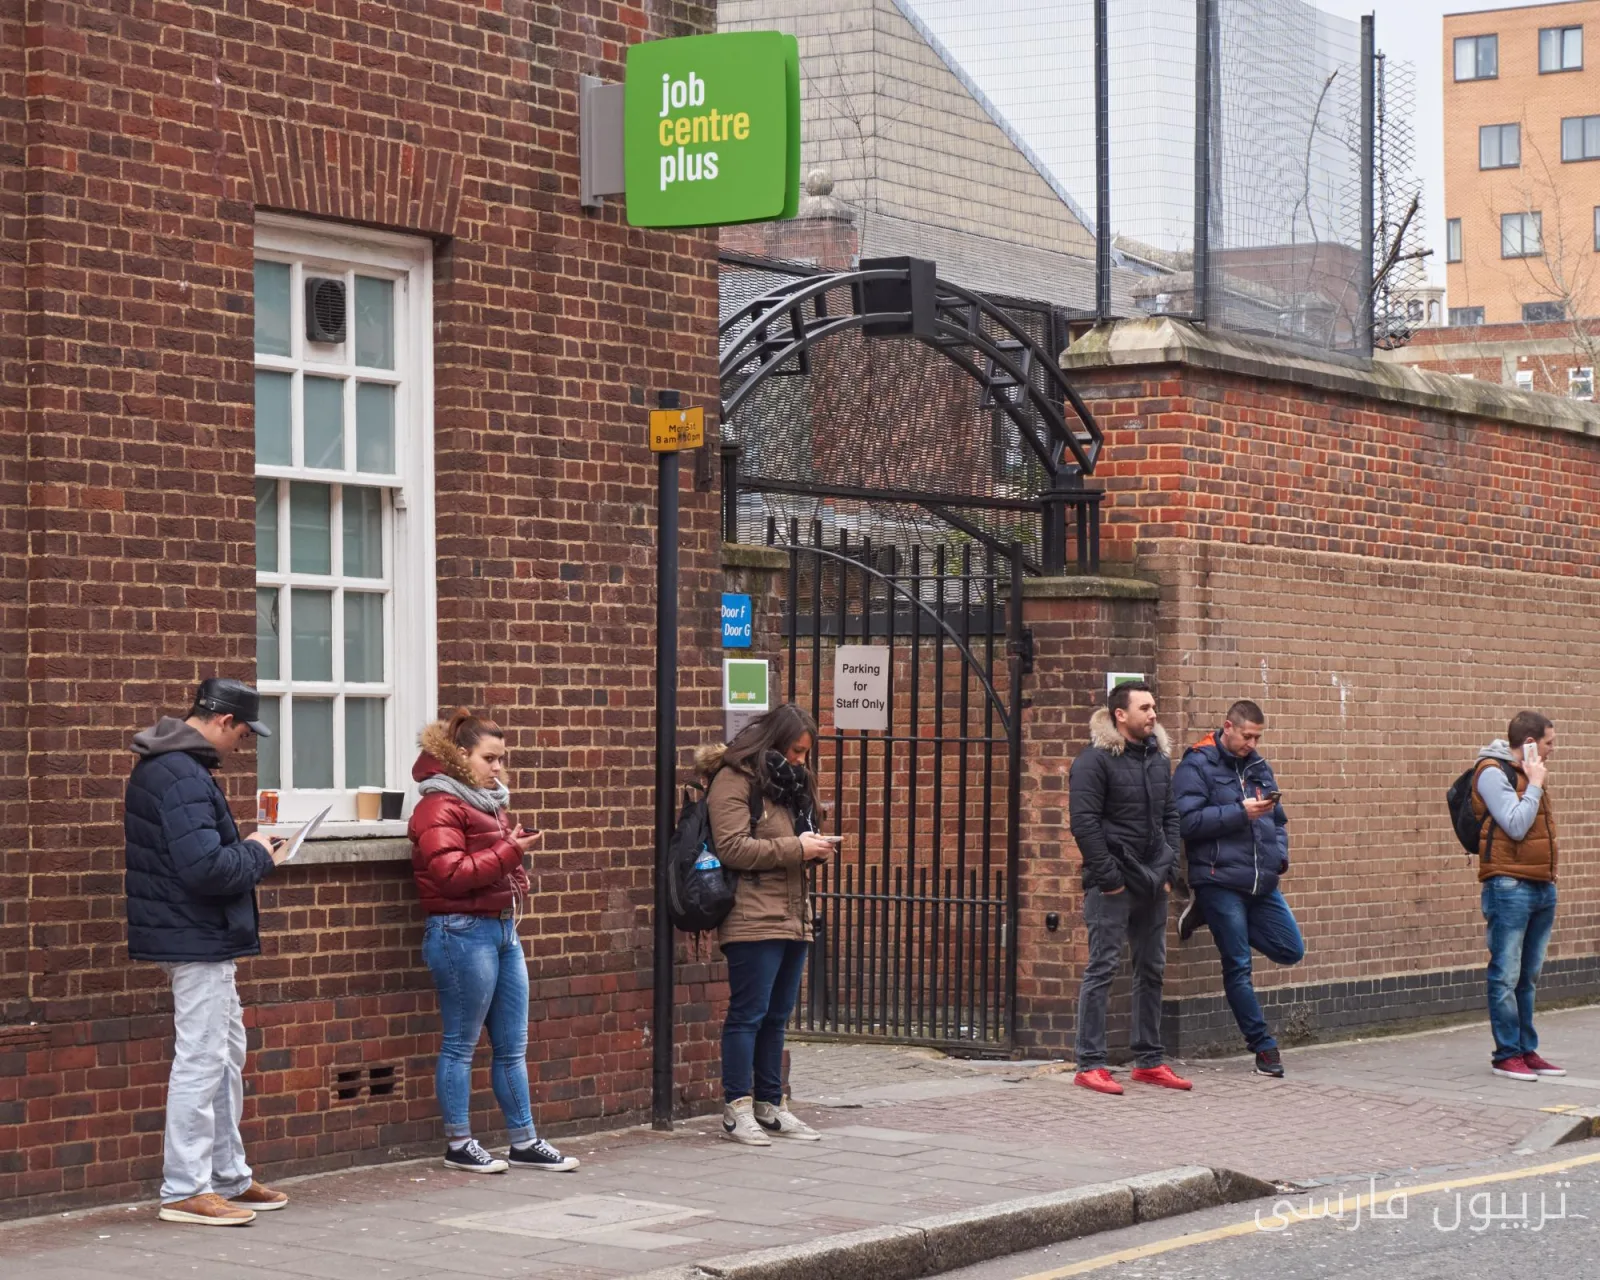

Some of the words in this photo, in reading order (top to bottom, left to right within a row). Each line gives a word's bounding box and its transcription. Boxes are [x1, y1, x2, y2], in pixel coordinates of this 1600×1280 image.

[659, 72, 705, 117] job
[659, 108, 750, 146] centre
[660, 147, 719, 191] plus
[721, 605, 739, 618] Door
[740, 605, 746, 618] F
[724, 623, 742, 636] Door
[744, 623, 751, 637] G
[842, 663, 880, 676] Parking
[853, 681, 868, 691] for
[836, 698, 860, 709] Staff
[861, 698, 885, 711] Only
